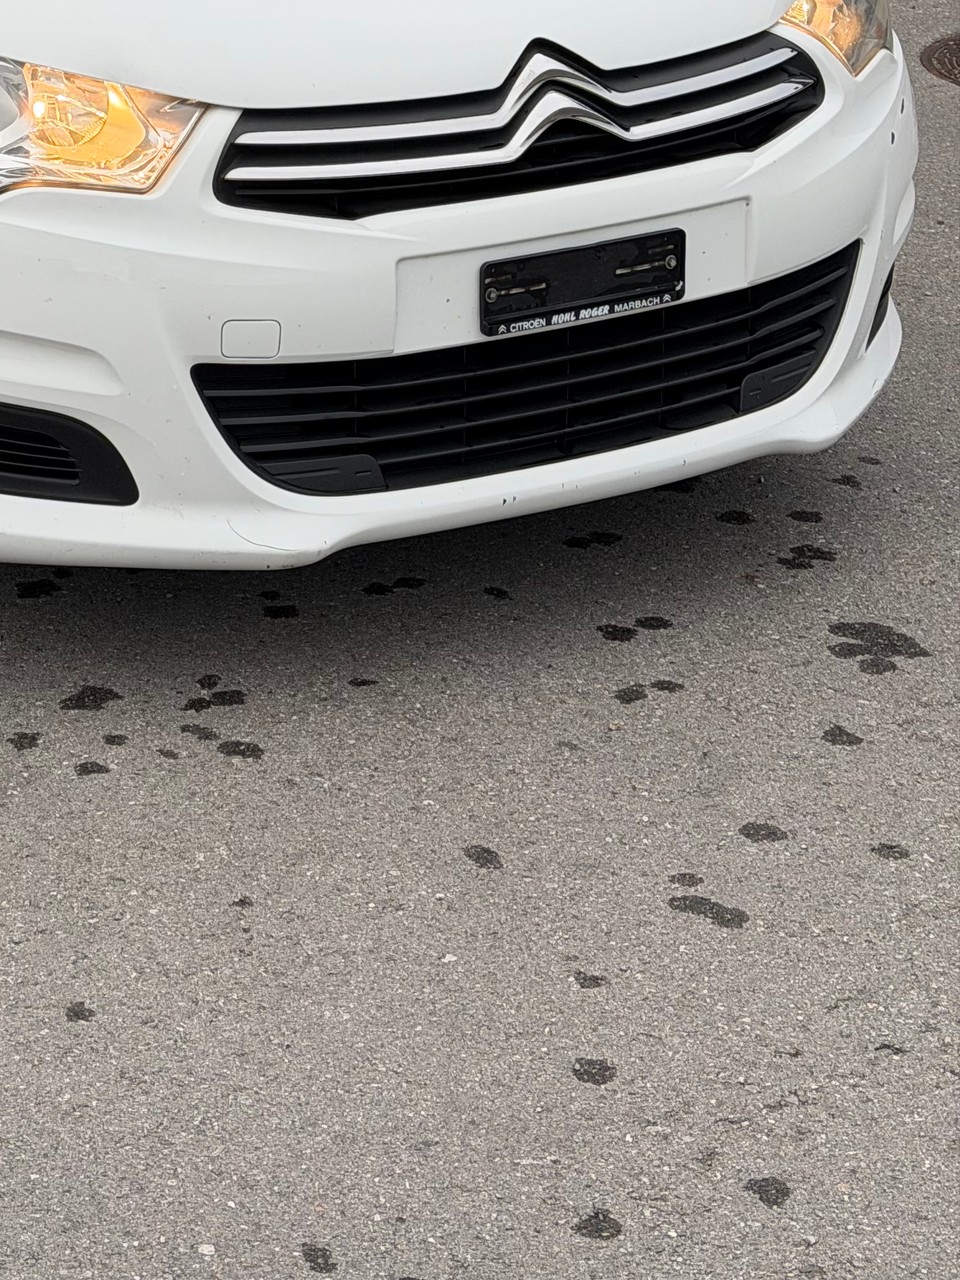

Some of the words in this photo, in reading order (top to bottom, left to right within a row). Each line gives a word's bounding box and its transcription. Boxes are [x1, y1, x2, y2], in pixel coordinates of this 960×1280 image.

[510, 318, 546, 332] CITROËN
[579, 304, 610, 320] ROGER
[614, 296, 660, 313] MARBACH
